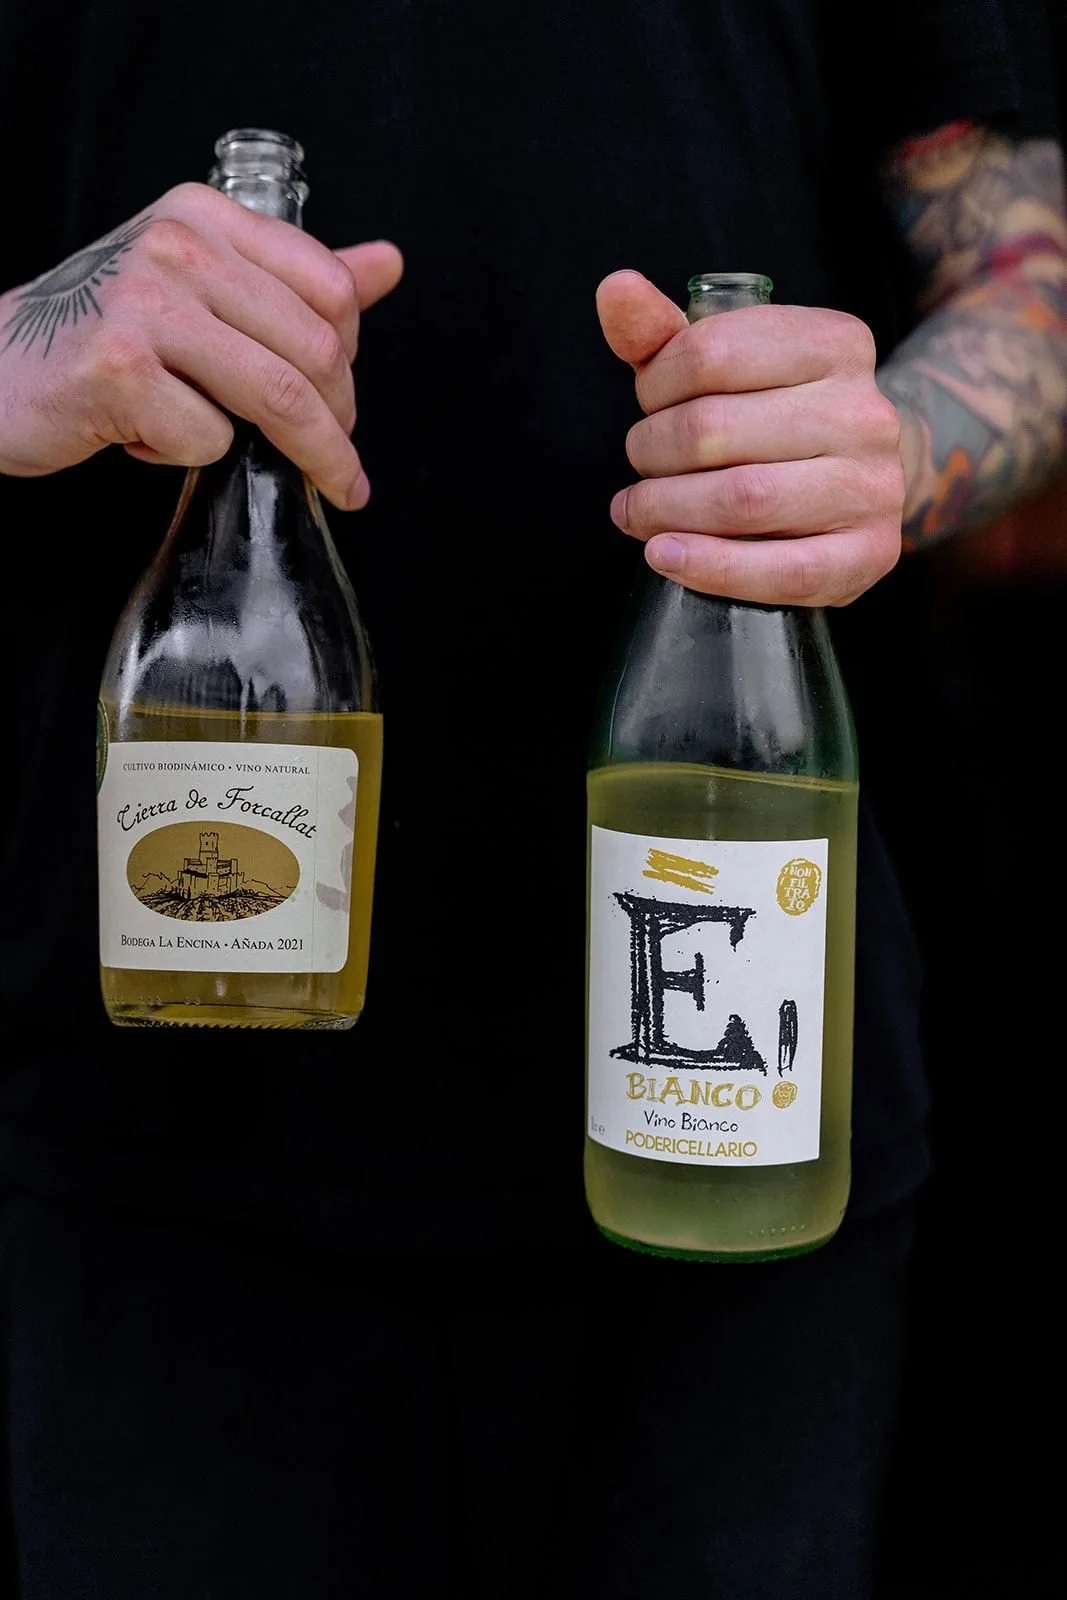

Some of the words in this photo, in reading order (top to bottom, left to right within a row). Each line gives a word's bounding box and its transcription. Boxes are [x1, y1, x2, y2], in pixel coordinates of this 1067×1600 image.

[122, 762, 156, 771] CULTIVO
[157, 761, 225, 772] BIODINÁMICO
[235, 765, 262, 773] VINO
[264, 765, 310, 775] NATURAL
[116, 798, 178, 832] Tierra
[185, 788, 208, 809] de
[217, 785, 318, 839] Forcallat
[789, 866, 812, 878] NON
[784, 887, 812, 899] TRA
[277, 938, 304, 951] 2021
[625, 1072, 762, 1110] BIANCO
[643, 1109, 677, 1129] Vino
[681, 1111, 739, 1133] Bianco
[625, 1130, 758, 1157] PODERICELLARIO
